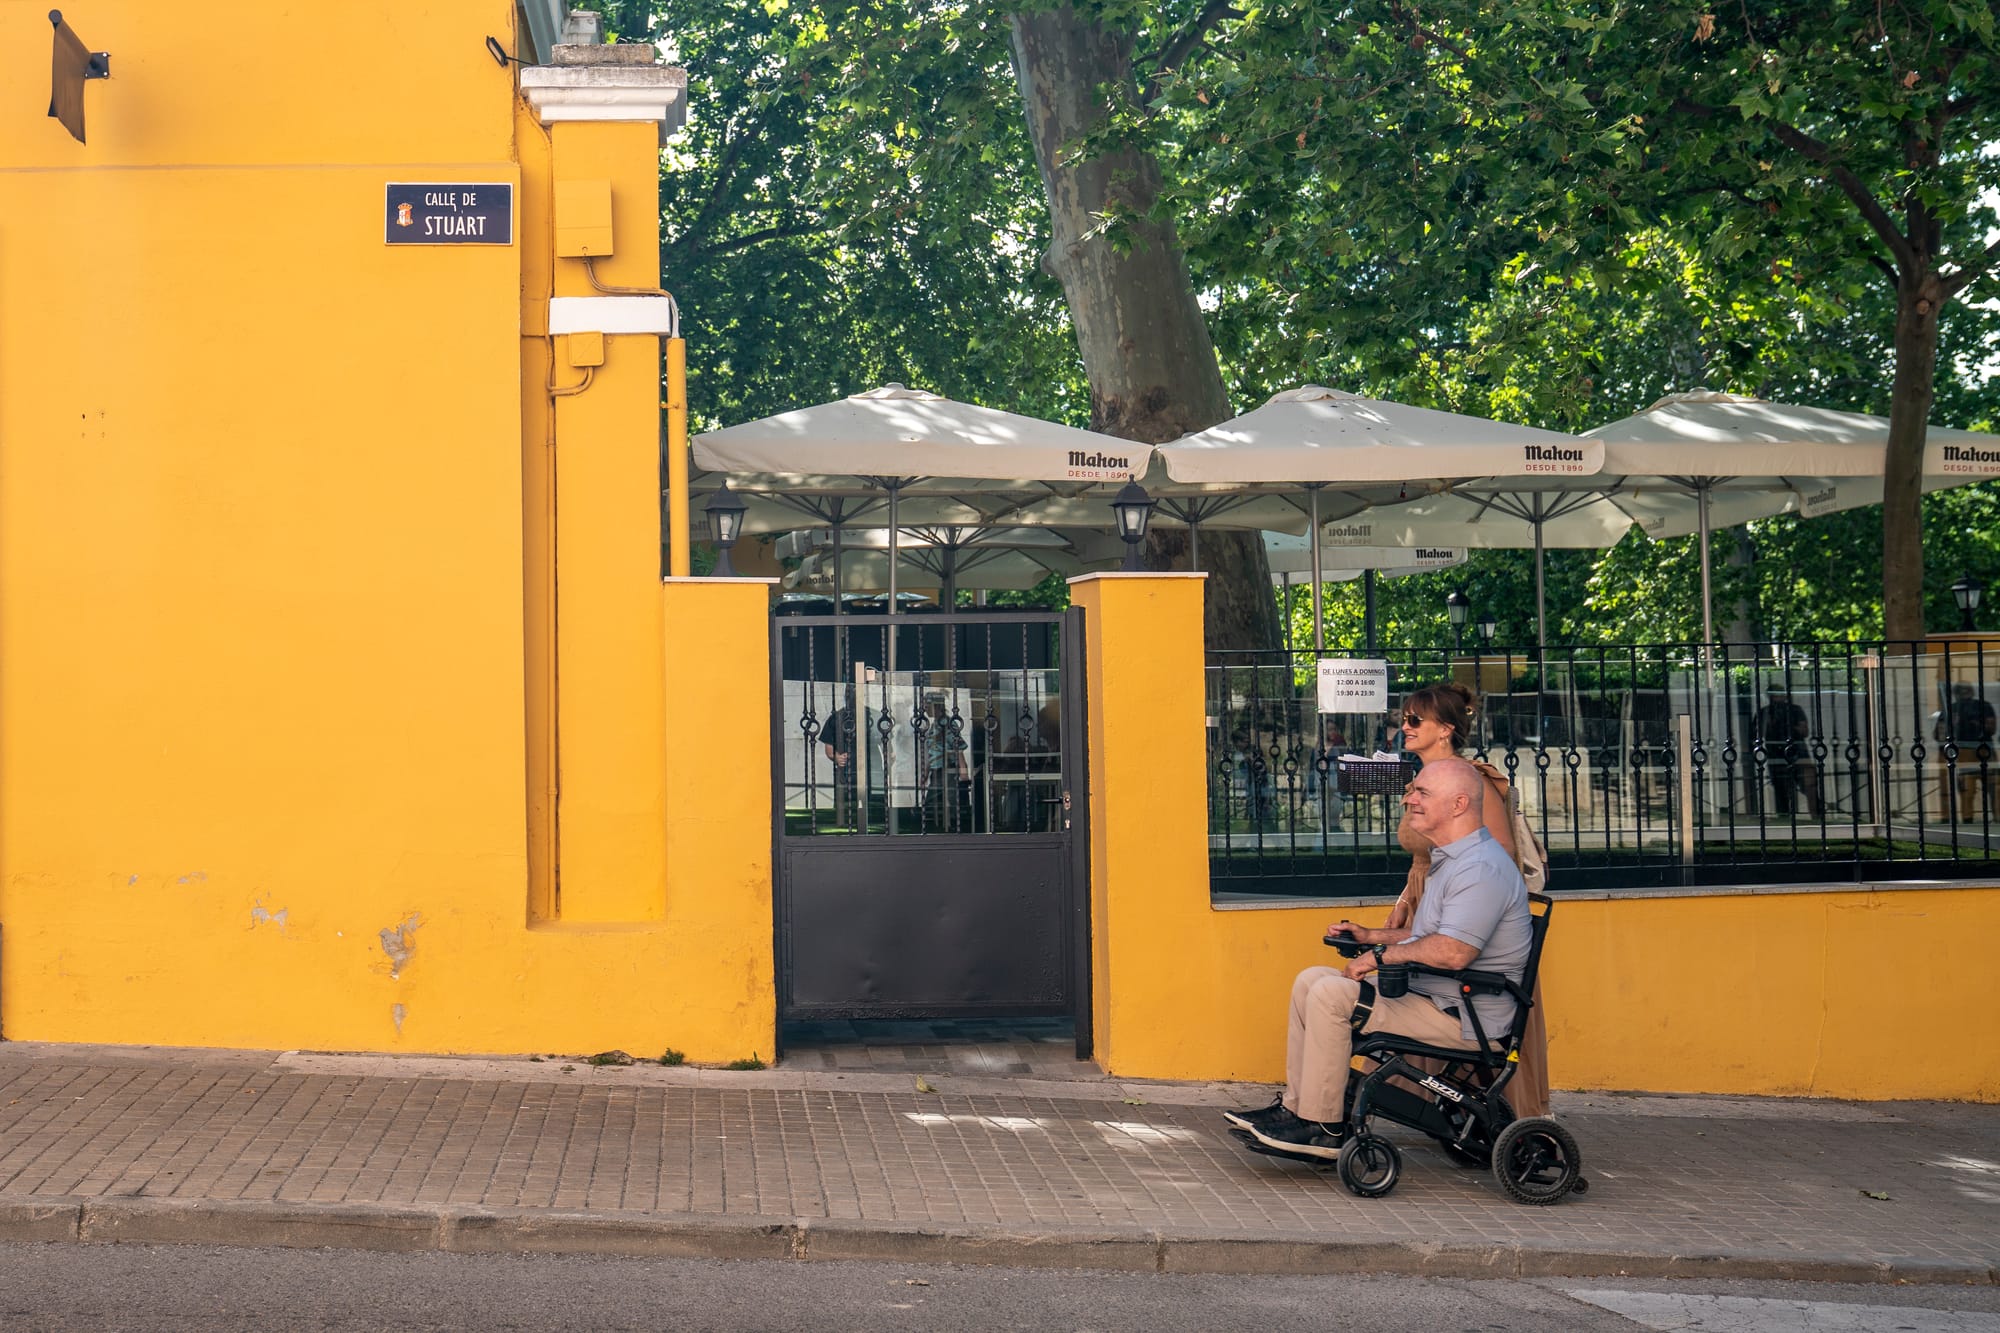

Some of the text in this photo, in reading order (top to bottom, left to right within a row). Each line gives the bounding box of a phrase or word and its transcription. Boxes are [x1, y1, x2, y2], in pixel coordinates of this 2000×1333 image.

[425, 193, 477, 206] CALLE DE
[425, 216, 487, 236] STUART
[1068, 450, 1129, 468] Mahou
[1525, 445, 1583, 461] Mahou
[1943, 446, 2000, 462] Mahou
[1068, 470, 1128, 479] DESDE 1890
[1561, 464, 1584, 472] 1890
[1943, 464, 1975, 472] DESDE
[1416, 548, 1453, 559] Mahou
[1420, 1076, 1464, 1102] Jazzy
